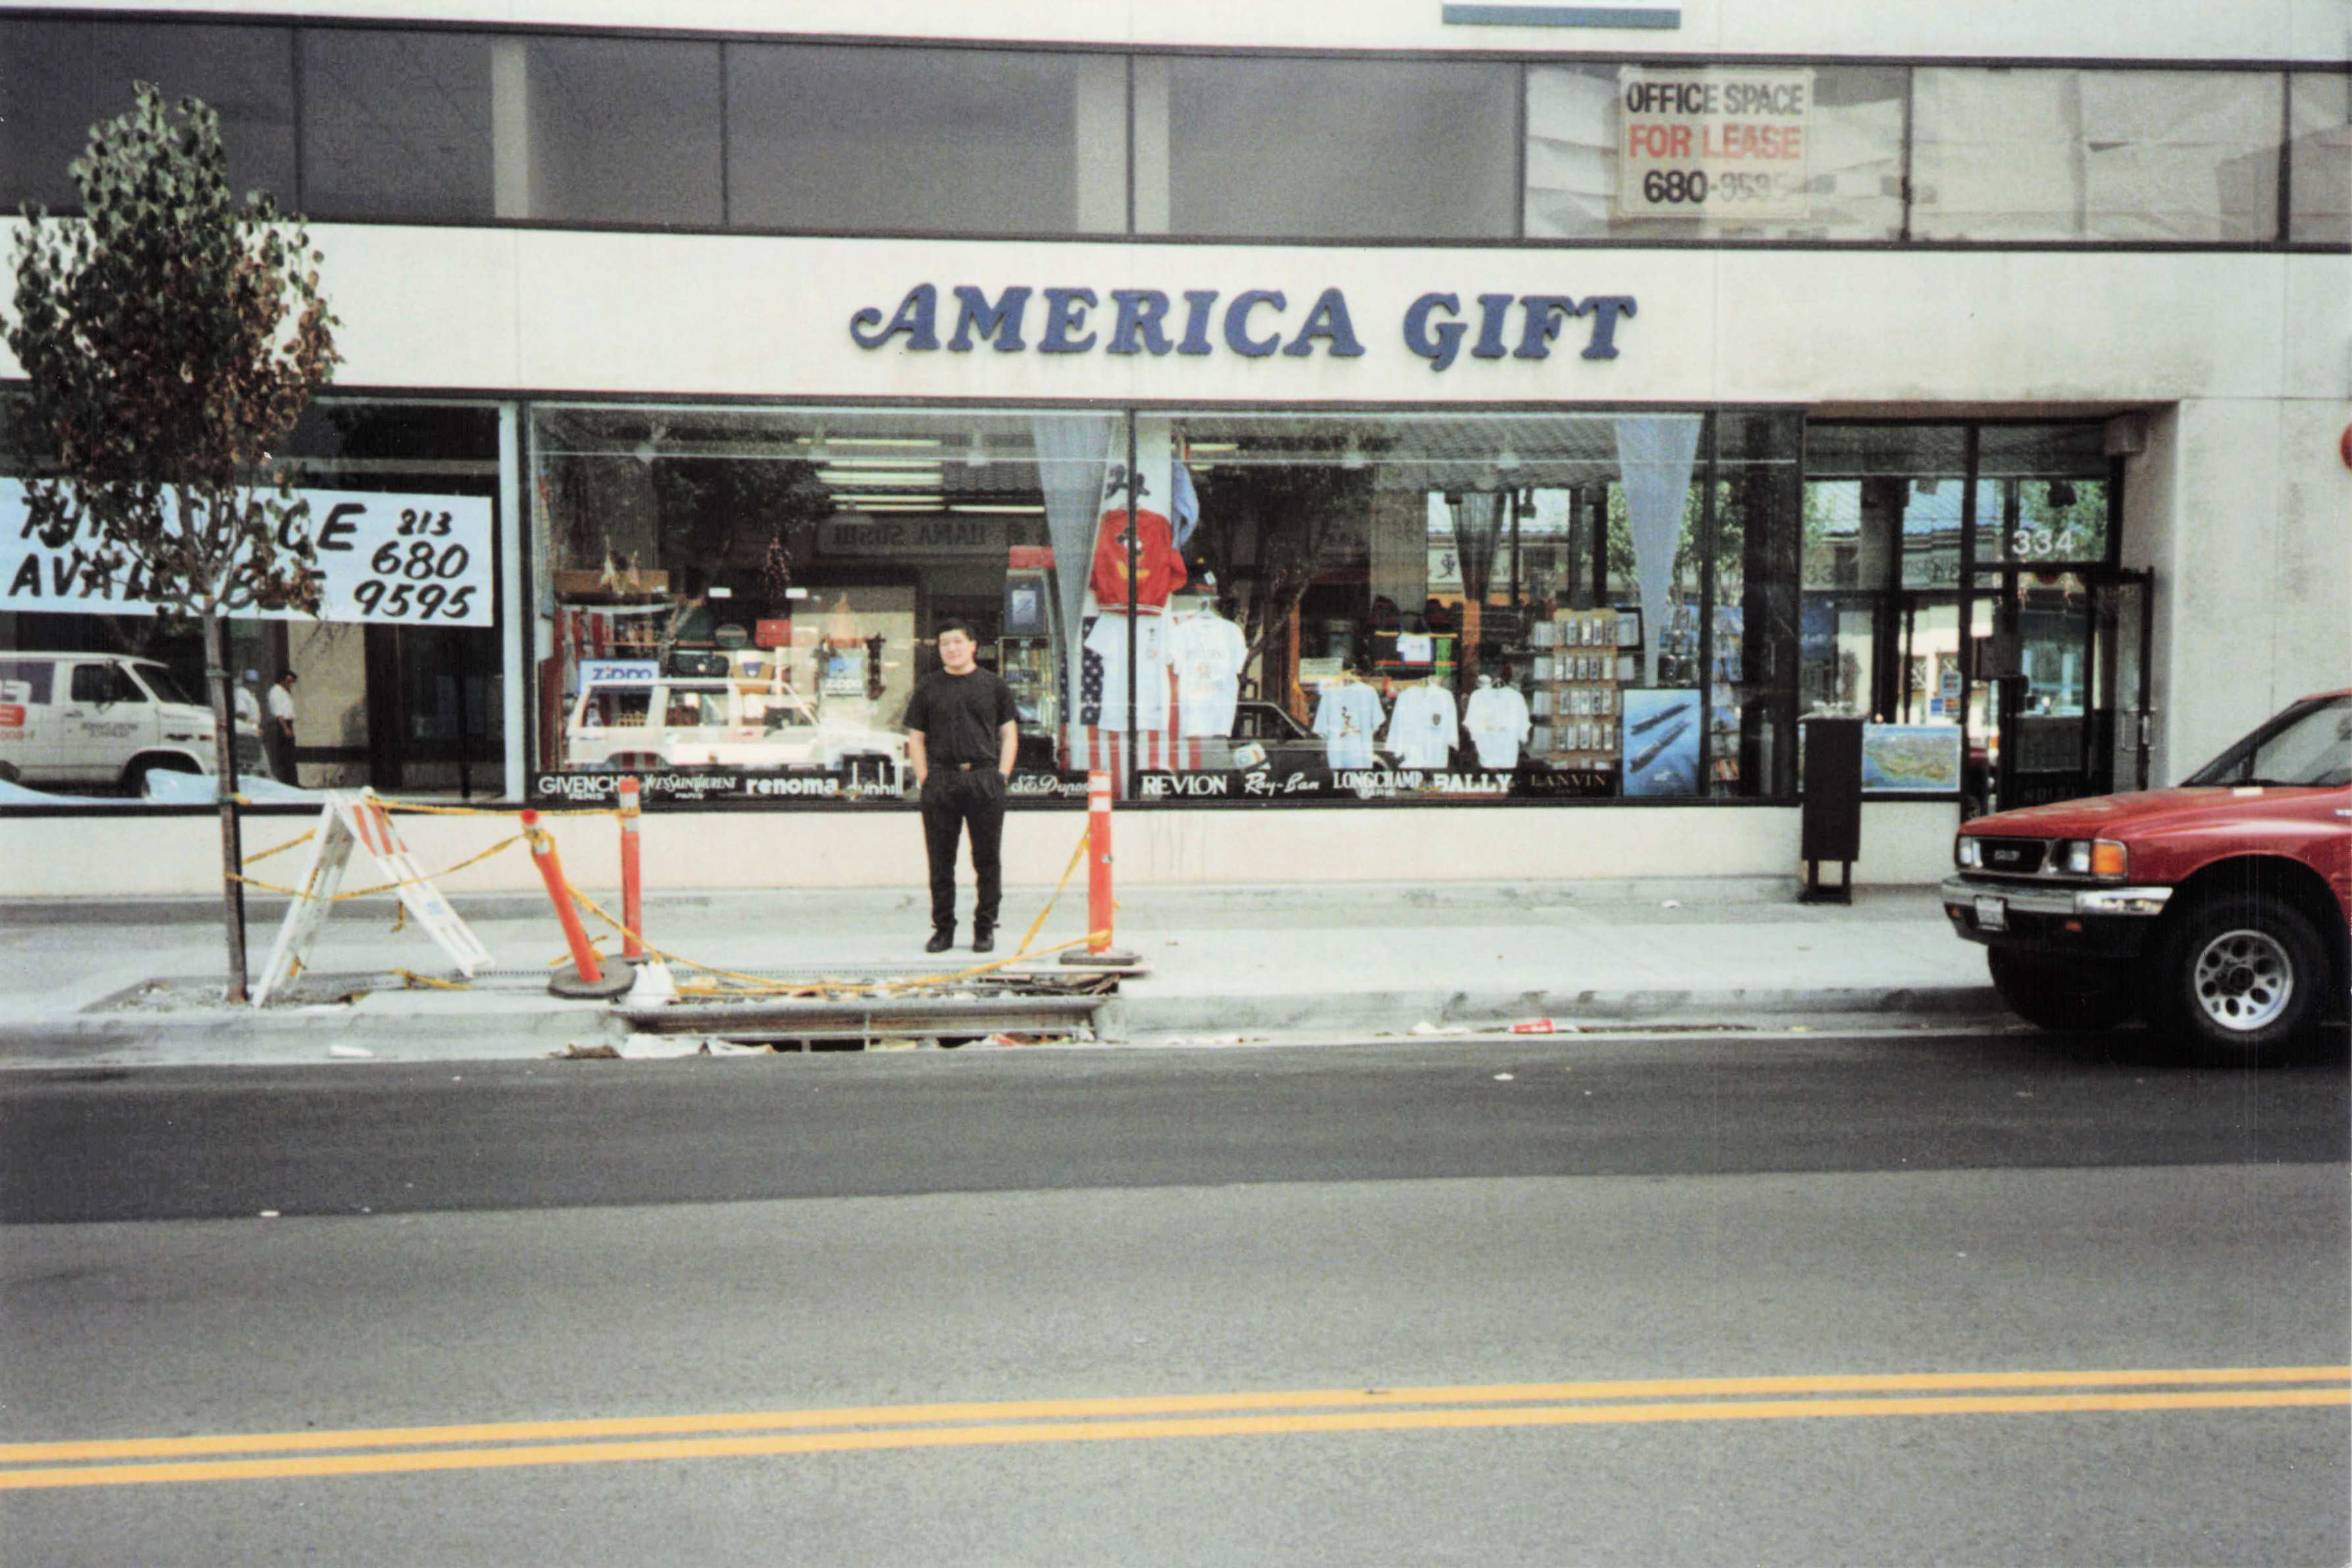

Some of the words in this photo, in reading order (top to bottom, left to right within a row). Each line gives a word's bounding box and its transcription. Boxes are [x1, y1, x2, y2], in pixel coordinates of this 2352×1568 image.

[1627, 82, 1719, 115] OFFICE
[1723, 82, 1803, 115] SPACE
[1628, 124, 1692, 159] FOR
[1700, 124, 1802, 159] LEASE
[849, 282, 1367, 359] AMERICA
[1402, 292, 1638, 373] GIFT
[397, 508, 453, 536] 213
[2012, 529, 2075, 556] 334
[371, 539, 469, 581] 680
[353, 579, 477, 620] 9595
[538, 775, 633, 794] GIVENCH
[746, 777, 838, 795] renoma
[1141, 774, 1228, 795] REVLON
[1243, 771, 1320, 797] Ray-Ban
[1332, 770, 1424, 789] LONGCHAMP
[1432, 773, 1513, 793] BALLY
[1530, 773, 1606, 787] LANVIN
